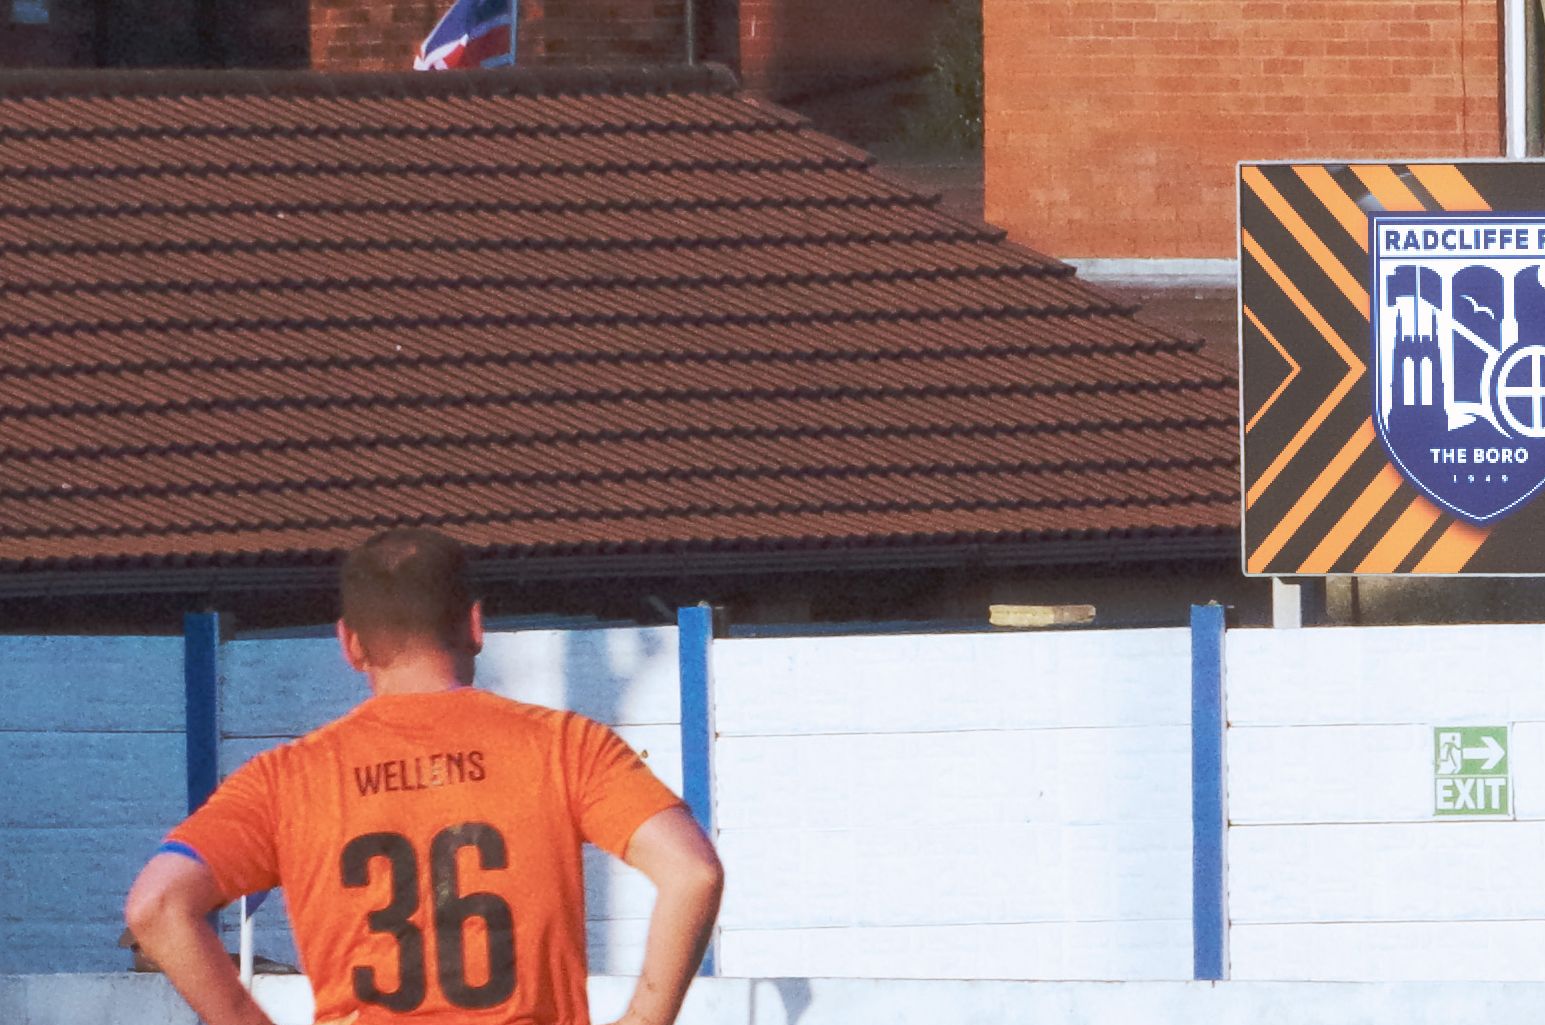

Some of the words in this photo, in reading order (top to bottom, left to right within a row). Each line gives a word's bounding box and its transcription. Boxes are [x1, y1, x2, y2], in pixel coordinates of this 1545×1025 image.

[1385, 228, 1530, 250] RADCLIFFE
[1429, 448, 1467, 464] THE
[1473, 447, 1529, 464] BORO
[354, 750, 486, 796] WELLENS
[1436, 777, 1507, 810] EXIT
[339, 821, 517, 1014] 36
